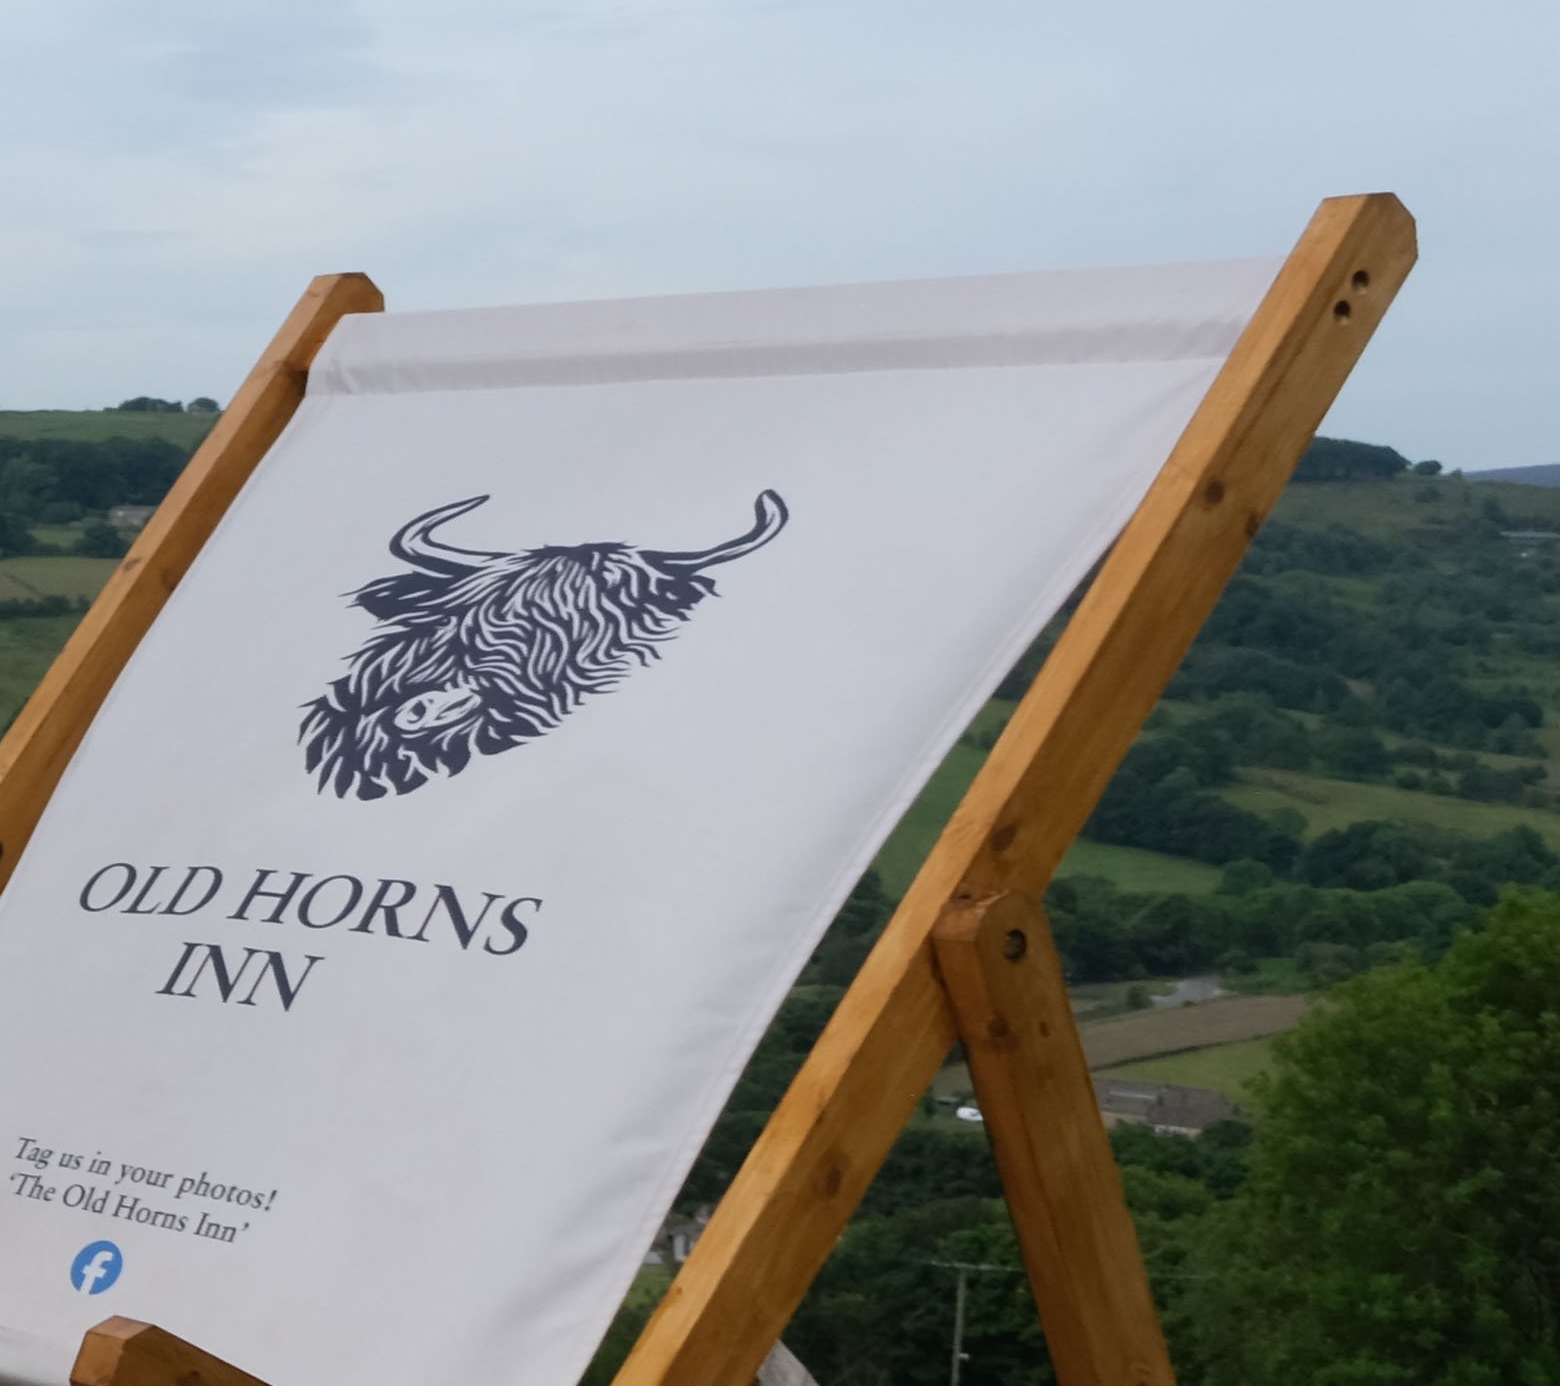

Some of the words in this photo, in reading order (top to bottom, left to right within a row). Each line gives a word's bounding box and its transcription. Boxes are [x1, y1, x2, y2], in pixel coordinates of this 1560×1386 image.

[78, 861, 224, 916] OLD
[226, 868, 544, 956] HORNS
[155, 941, 326, 1012] INN
[14, 1136, 55, 1170] Tag
[58, 1149, 85, 1171] us
[87, 1150, 112, 1176] in
[113, 1163, 175, 1189] your
[173, 1171, 279, 1213] photos!
[62, 1183, 111, 1214] Old
[111, 1193, 190, 1232] Horns
